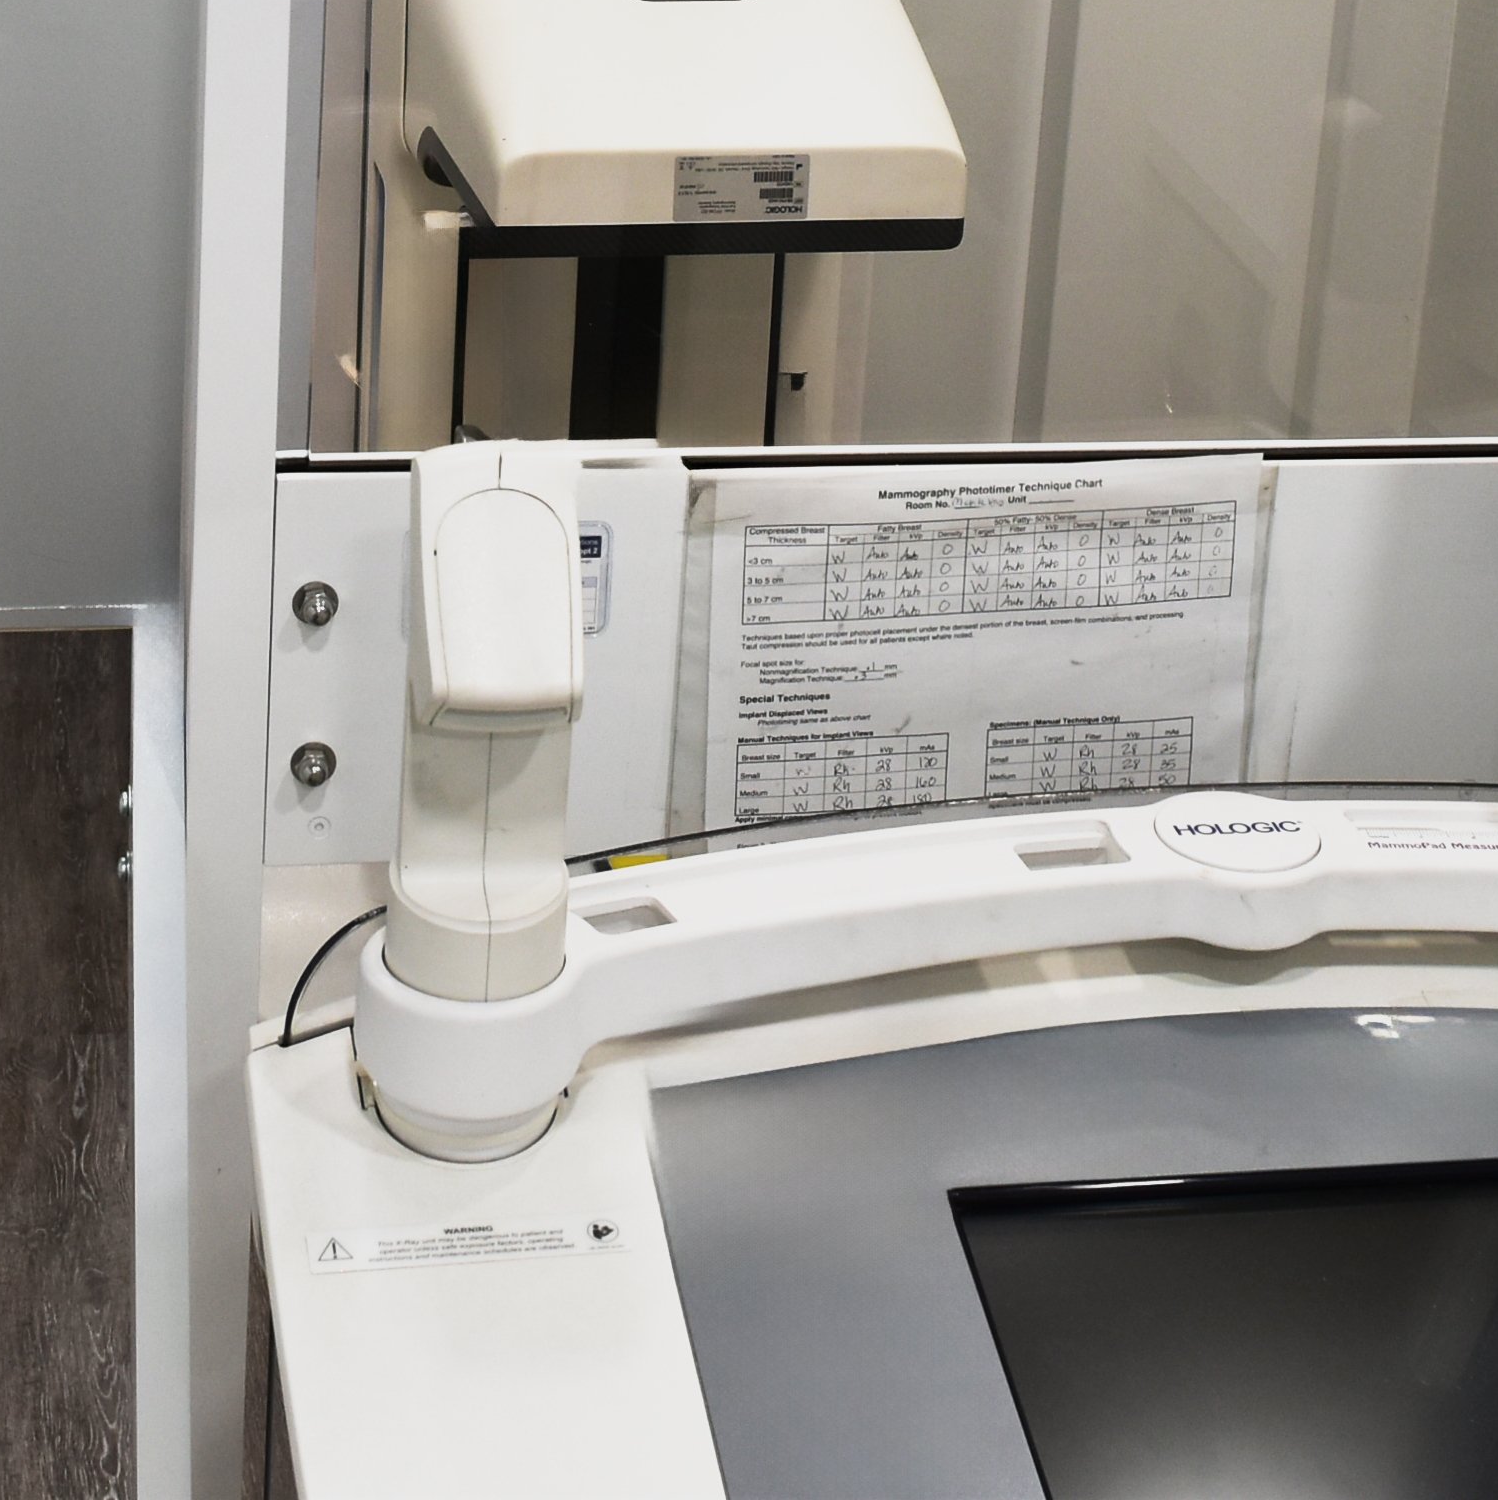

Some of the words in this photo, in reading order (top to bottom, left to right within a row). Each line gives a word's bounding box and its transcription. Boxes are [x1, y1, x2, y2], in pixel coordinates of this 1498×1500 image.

[879, 490, 955, 499] Mammography
[959, 484, 1015, 496] Phototimer
[1019, 481, 1071, 492] Technique
[1075, 479, 1102, 488] Chart
[906, 501, 933, 509] Room
[935, 500, 950, 509] No.
[1008, 496, 1026, 504] Unit
[1147, 507, 1169, 516] Dense
[1172, 506, 1194, 514] Breast
[994, 518, 1009, 527] 50%
[1035, 515, 1051, 523] 50%
[1054, 513, 1077, 522] Dense
[749, 527, 799, 536] Compressed
[801, 526, 825, 534] Breast
[835, 536, 858, 544] Target
[937, 530, 963, 539] Density
[974, 527, 995, 537] Target
[1109, 519, 1131, 528] Target
[1207, 513, 1231, 522] Density
[878, 525, 896, 533] Fatty
[899, 523, 922, 531] Breast
[769, 536, 807, 544] Thickness
[832, 551, 845, 564] W
[971, 543, 988, 555] W
[1108, 534, 1120, 545] W
[742, 634, 782, 642] Techniques
[784, 632, 805, 640] based
[807, 632, 824, 640] upon
[826, 631, 848, 639] proper
[850, 629, 881, 638] photocell
[883, 627, 917, 636] placement
[919, 625, 938, 633] under
[952, 623, 978, 631] densest
[980, 621, 1003, 630] portion
[1150, 612, 1184, 620] processing
[759, 640, 803, 651] compression
[805, 639, 827, 647] should
[829, 638, 838, 646] be
[840, 638, 856, 646] used
[859, 637, 867, 645] for
[879, 635, 906, 645] patients
[908, 634, 929, 642] except
[760, 667, 818, 676] Nonmagnification
[760, 676, 805, 685] Magnification
[739, 694, 774, 705] Special
[778, 692, 830, 702] Techniques
[739, 710, 767, 719] Implant
[769, 709, 805, 718] Displaced
[758, 718, 798, 727] Phototiming
[830, 715, 853, 723] above
[1034, 718, 1061, 727] (Manual
[1063, 716, 1099, 725] Technique
[1102, 715, 1120, 723] Only)
[767, 733, 809, 742] Techniques
[822, 731, 850, 739] Implant
[1043, 735, 1064, 743] Target
[794, 752, 816, 760] Target
[838, 749, 855, 757] Filter
[880, 746, 893, 754] kVp
[1043, 748, 1057, 761] W
[1079, 745, 1094, 758] Rh
[1122, 743, 1136, 755] 28
[1160, 743, 1177, 754] 25
[876, 759, 891, 772] 28
[919, 757, 938, 768] 120
[1040, 764, 1056, 777] W
[1079, 762, 1096, 775] Rh
[1122, 759, 1141, 769] 28
[1160, 759, 1175, 769] 35
[793, 783, 808, 796] W
[833, 777, 850, 793] Rh
[876, 778, 892, 791] 28
[915, 777, 936, 789] 160
[1040, 780, 1056, 791] W
[1159, 774, 1176, 786] 50
[739, 789, 768, 797] Medium
[793, 801, 808, 812] W
[833, 795, 853, 810] Rh
[1173, 821, 1301, 835] HOLOGIC
[1368, 841, 1447, 849] MammoPad
[444, 1225, 493, 1234] WARNING
